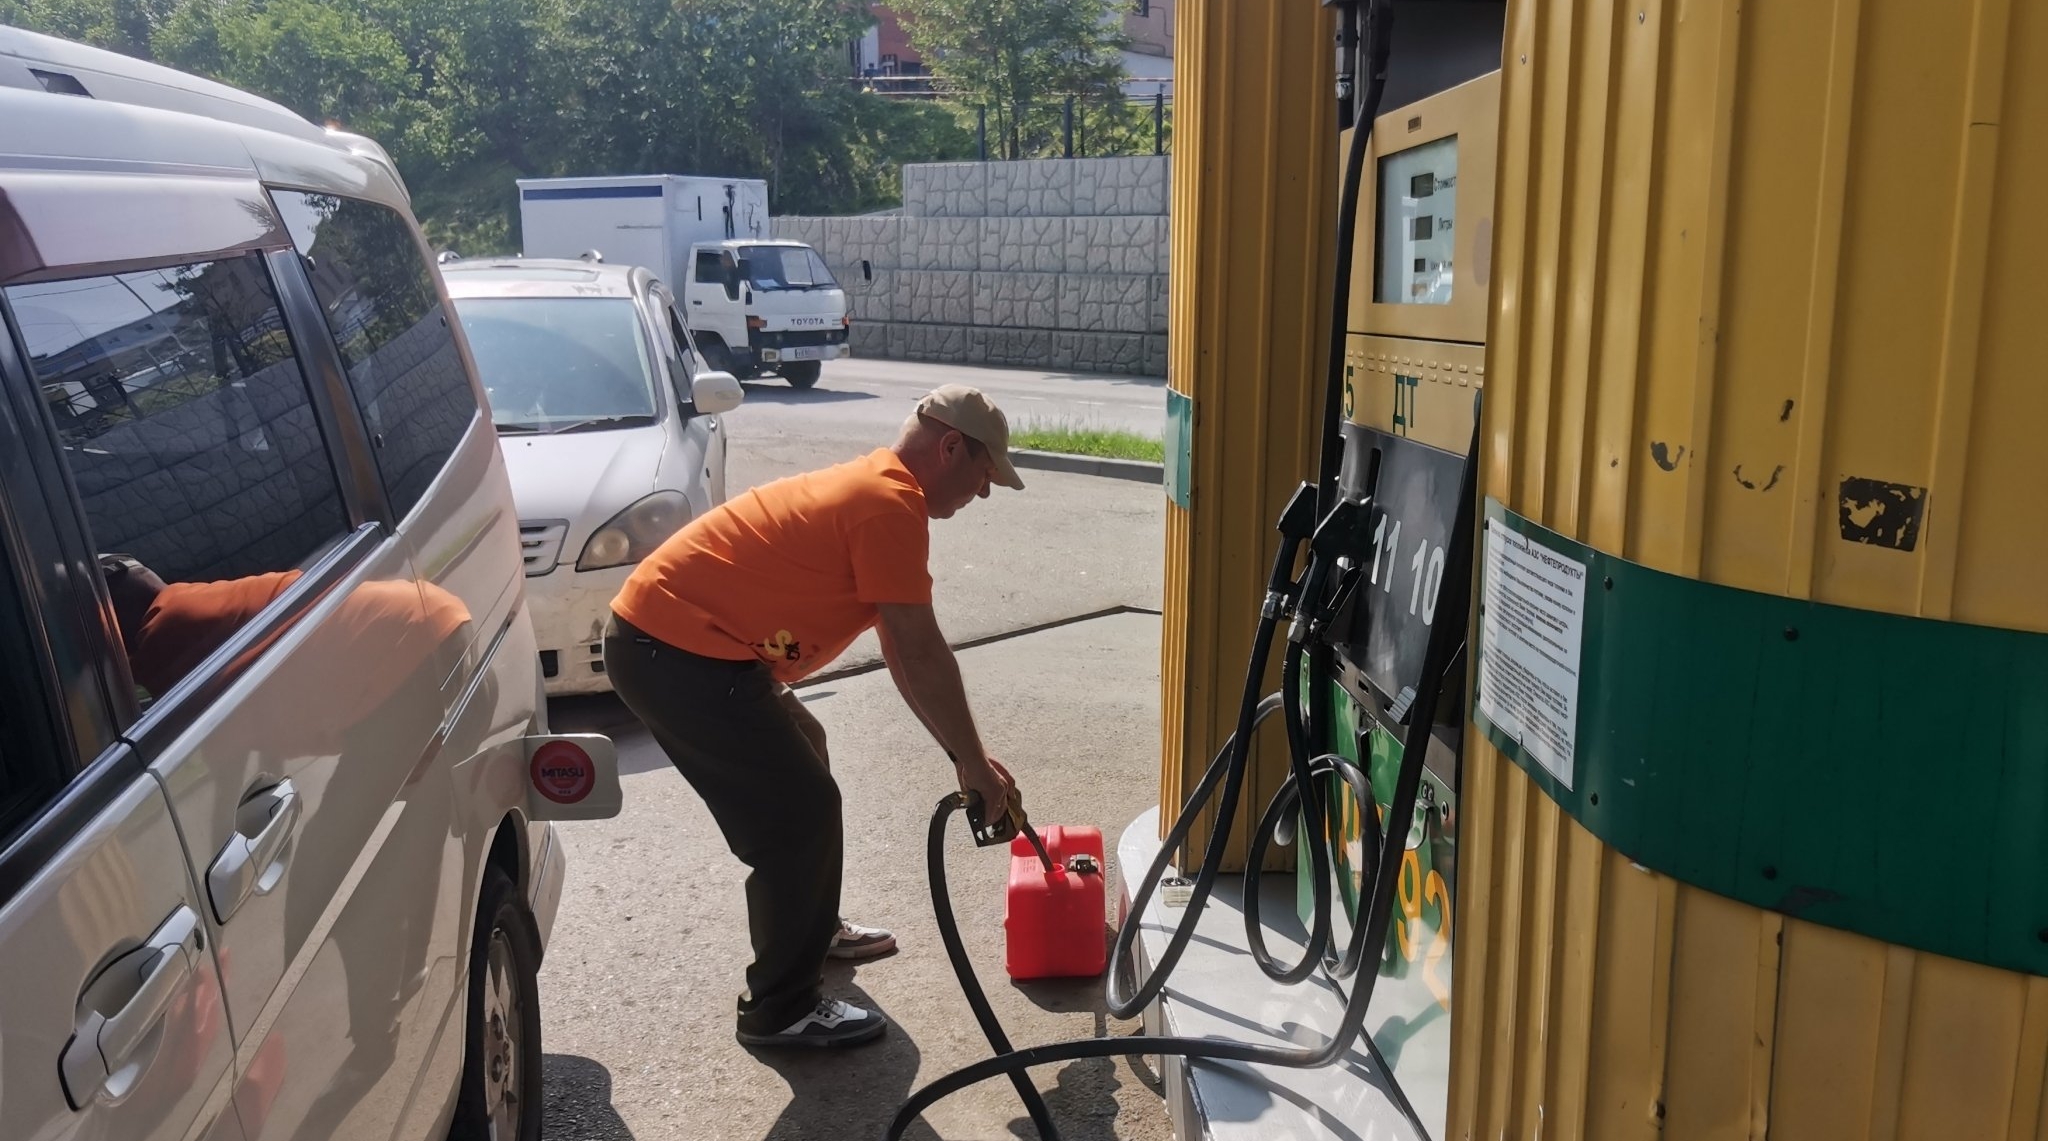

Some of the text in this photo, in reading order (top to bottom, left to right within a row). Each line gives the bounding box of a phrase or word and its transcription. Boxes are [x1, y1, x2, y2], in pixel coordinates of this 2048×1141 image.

[1433, 176, 1457, 192] Стоимост
[791, 318, 824, 326] TOYOTA
[1345, 366, 1418, 437] 5 ДТ
[1371, 513, 1401, 593] 11
[1410, 539, 1444, 626] 10
[541, 767, 585, 778] MITASU
[1398, 848, 1450, 1014] 92
